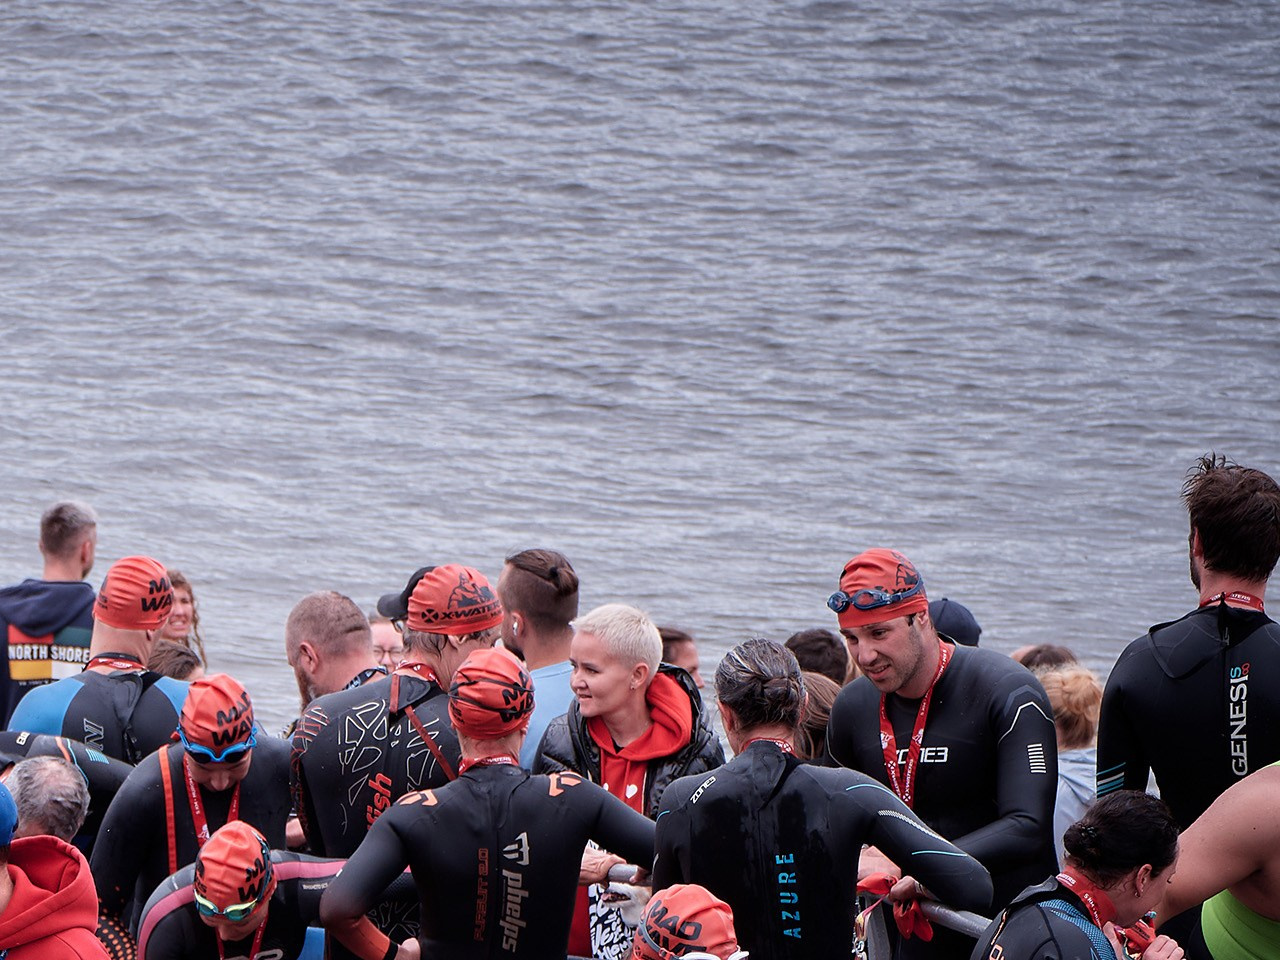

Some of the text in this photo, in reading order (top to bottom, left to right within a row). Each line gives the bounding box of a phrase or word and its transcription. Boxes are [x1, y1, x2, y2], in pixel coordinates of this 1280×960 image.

[8, 643, 91, 663] NORTH SHORE
[1230, 666, 1248, 776] GENESIS
[498, 868, 530, 953] phelps
[648, 900, 703, 941] MAD
[775, 853, 802, 939] AZURE
